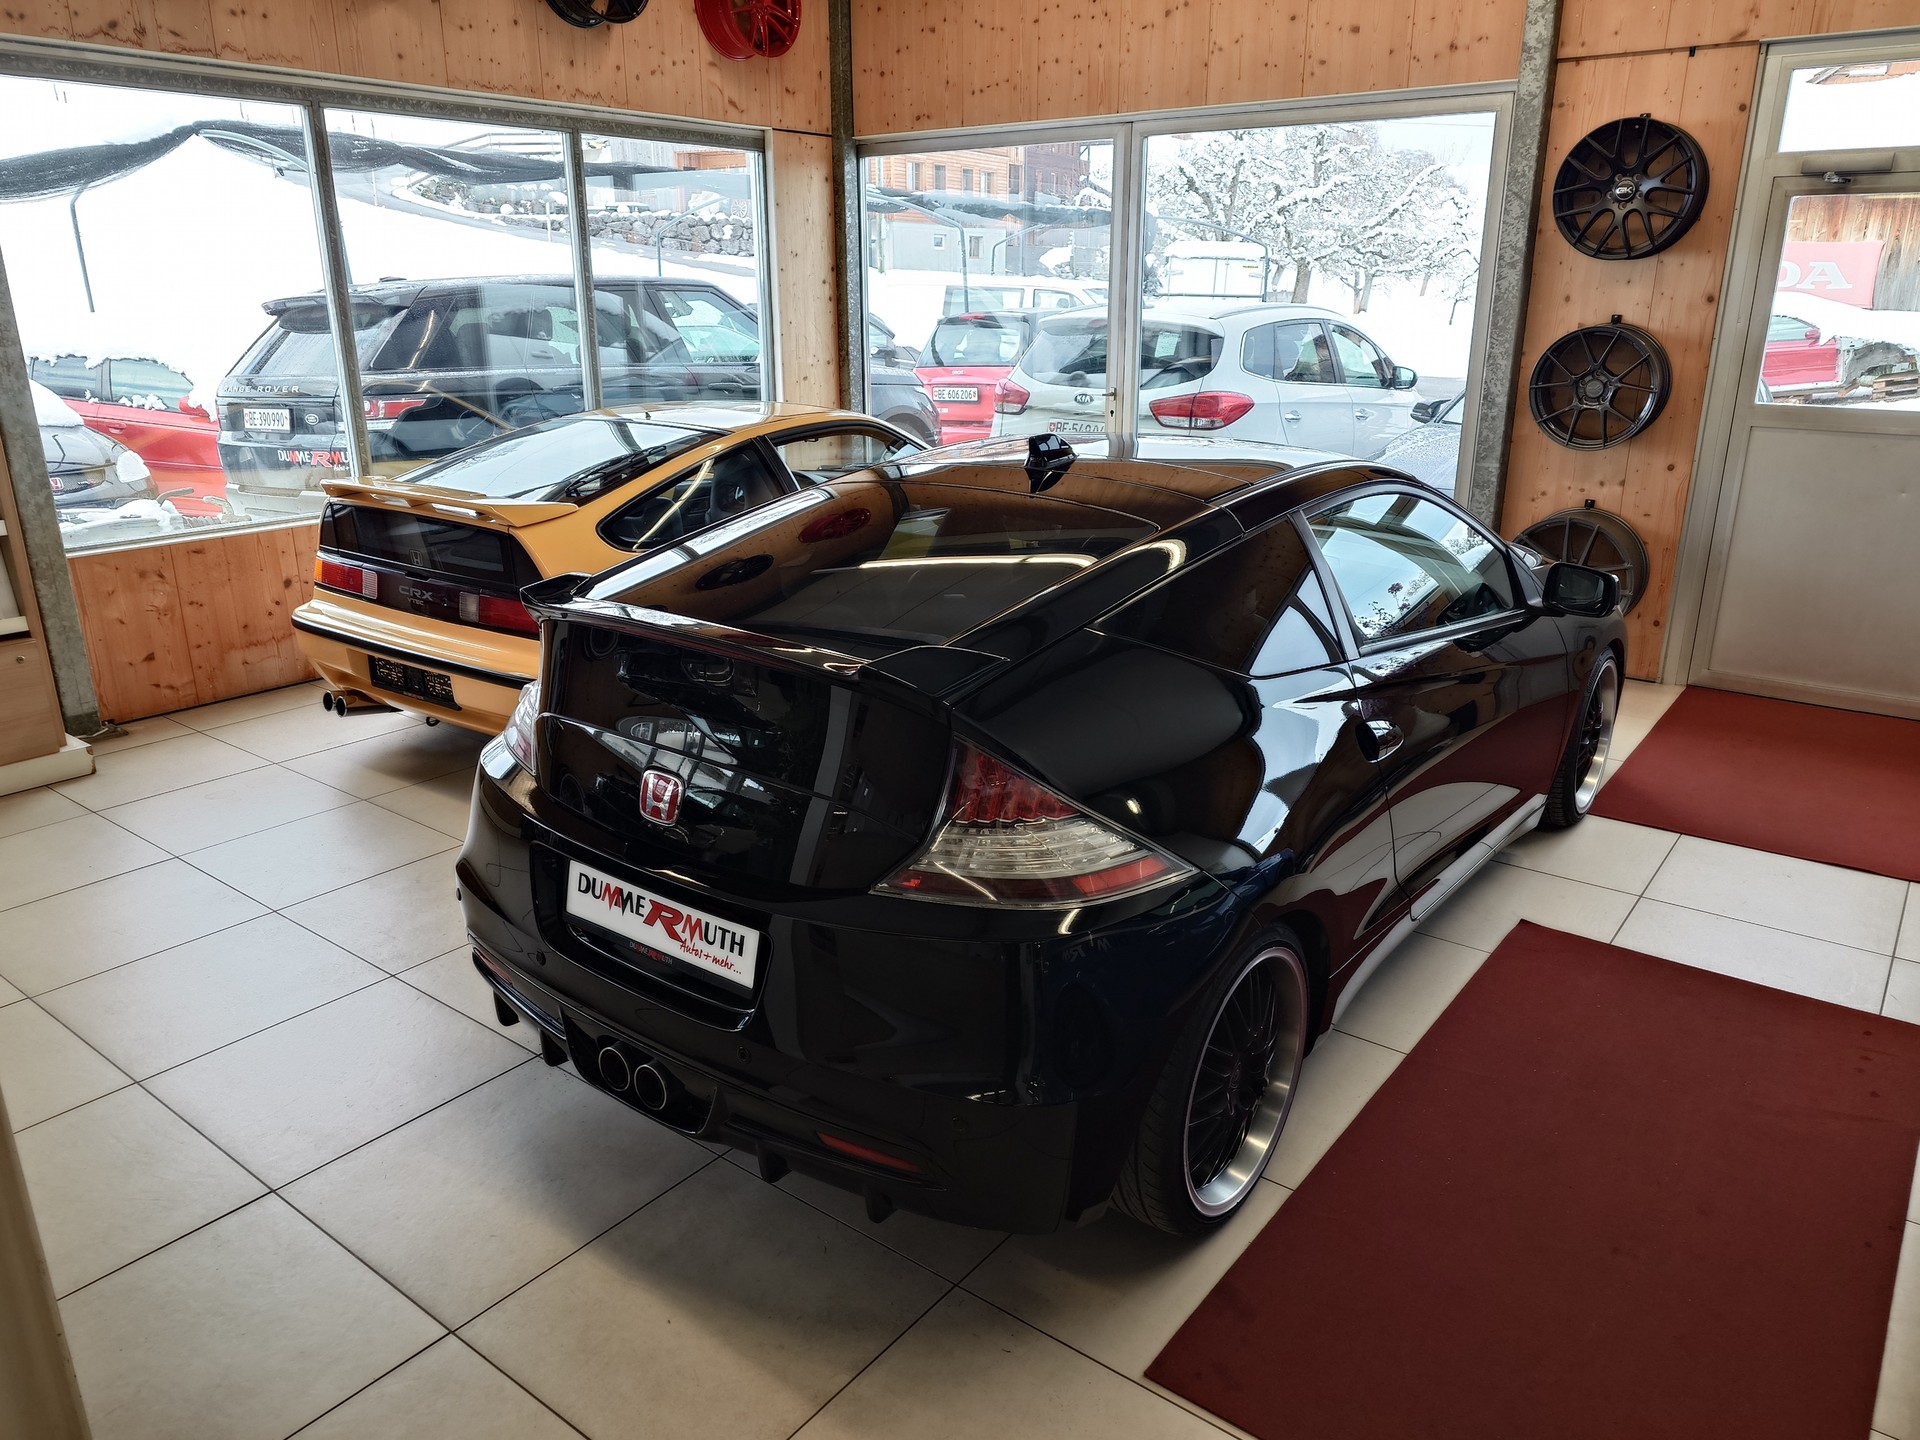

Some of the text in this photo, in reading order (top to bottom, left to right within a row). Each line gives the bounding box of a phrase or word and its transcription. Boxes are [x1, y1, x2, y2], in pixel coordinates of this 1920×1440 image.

[257, 385, 300, 393] ROVER
[1077, 395, 1091, 403] KIA
[399, 585, 433, 601] CRX
[680, 938, 703, 959] Autos
